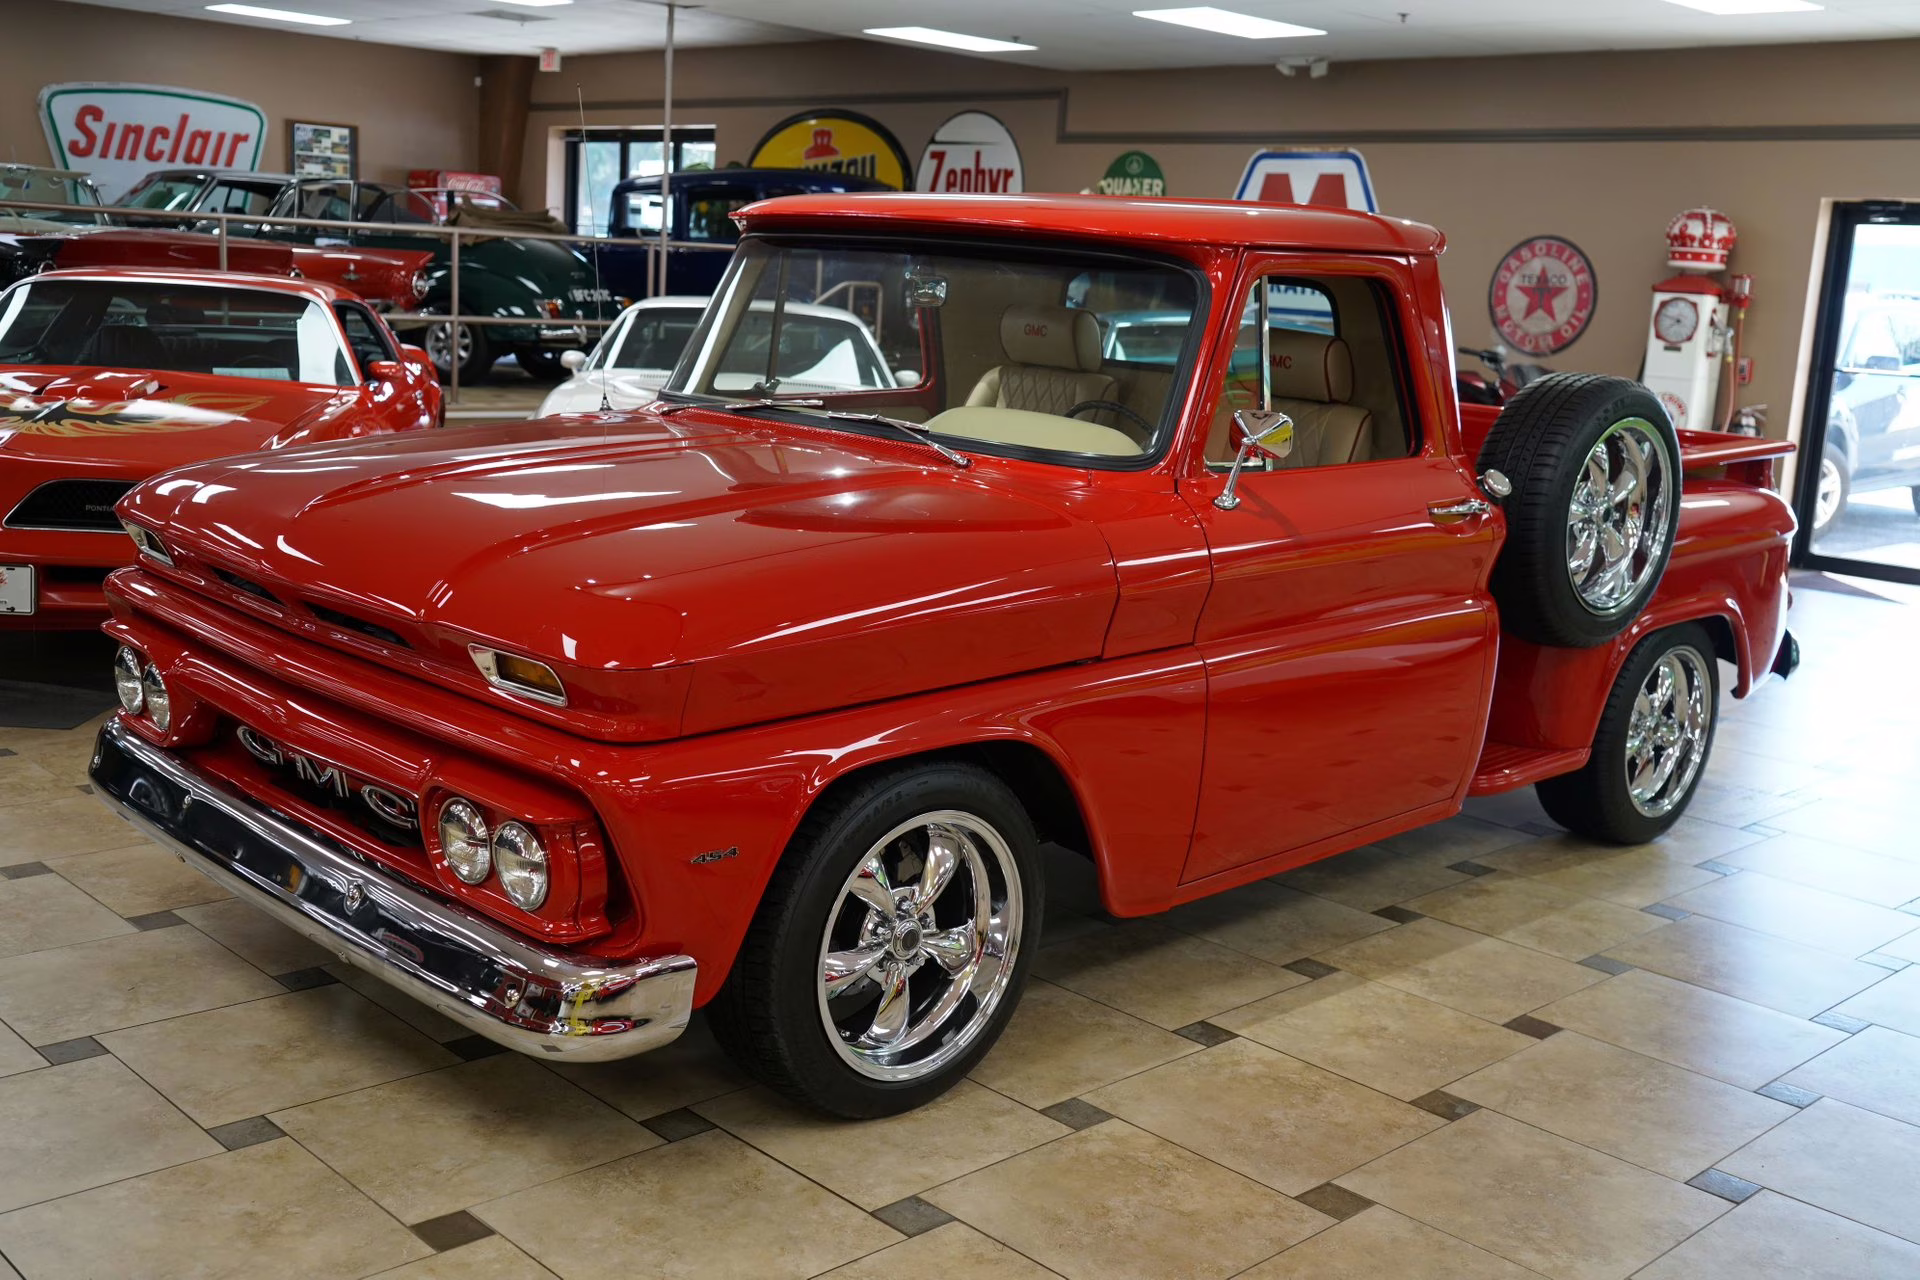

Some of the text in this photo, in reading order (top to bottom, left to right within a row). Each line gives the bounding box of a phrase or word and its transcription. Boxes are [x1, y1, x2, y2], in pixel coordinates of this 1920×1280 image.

[68, 104, 249, 168] Sinclair
[929, 150, 1014, 193] Zephyr
[1499, 241, 1590, 285] GASOLINE
[1023, 323, 1048, 337] GMC
[1560, 308, 1588, 337] OIL
[236, 725, 419, 830] GMC
[690, 845, 740, 865] 454
